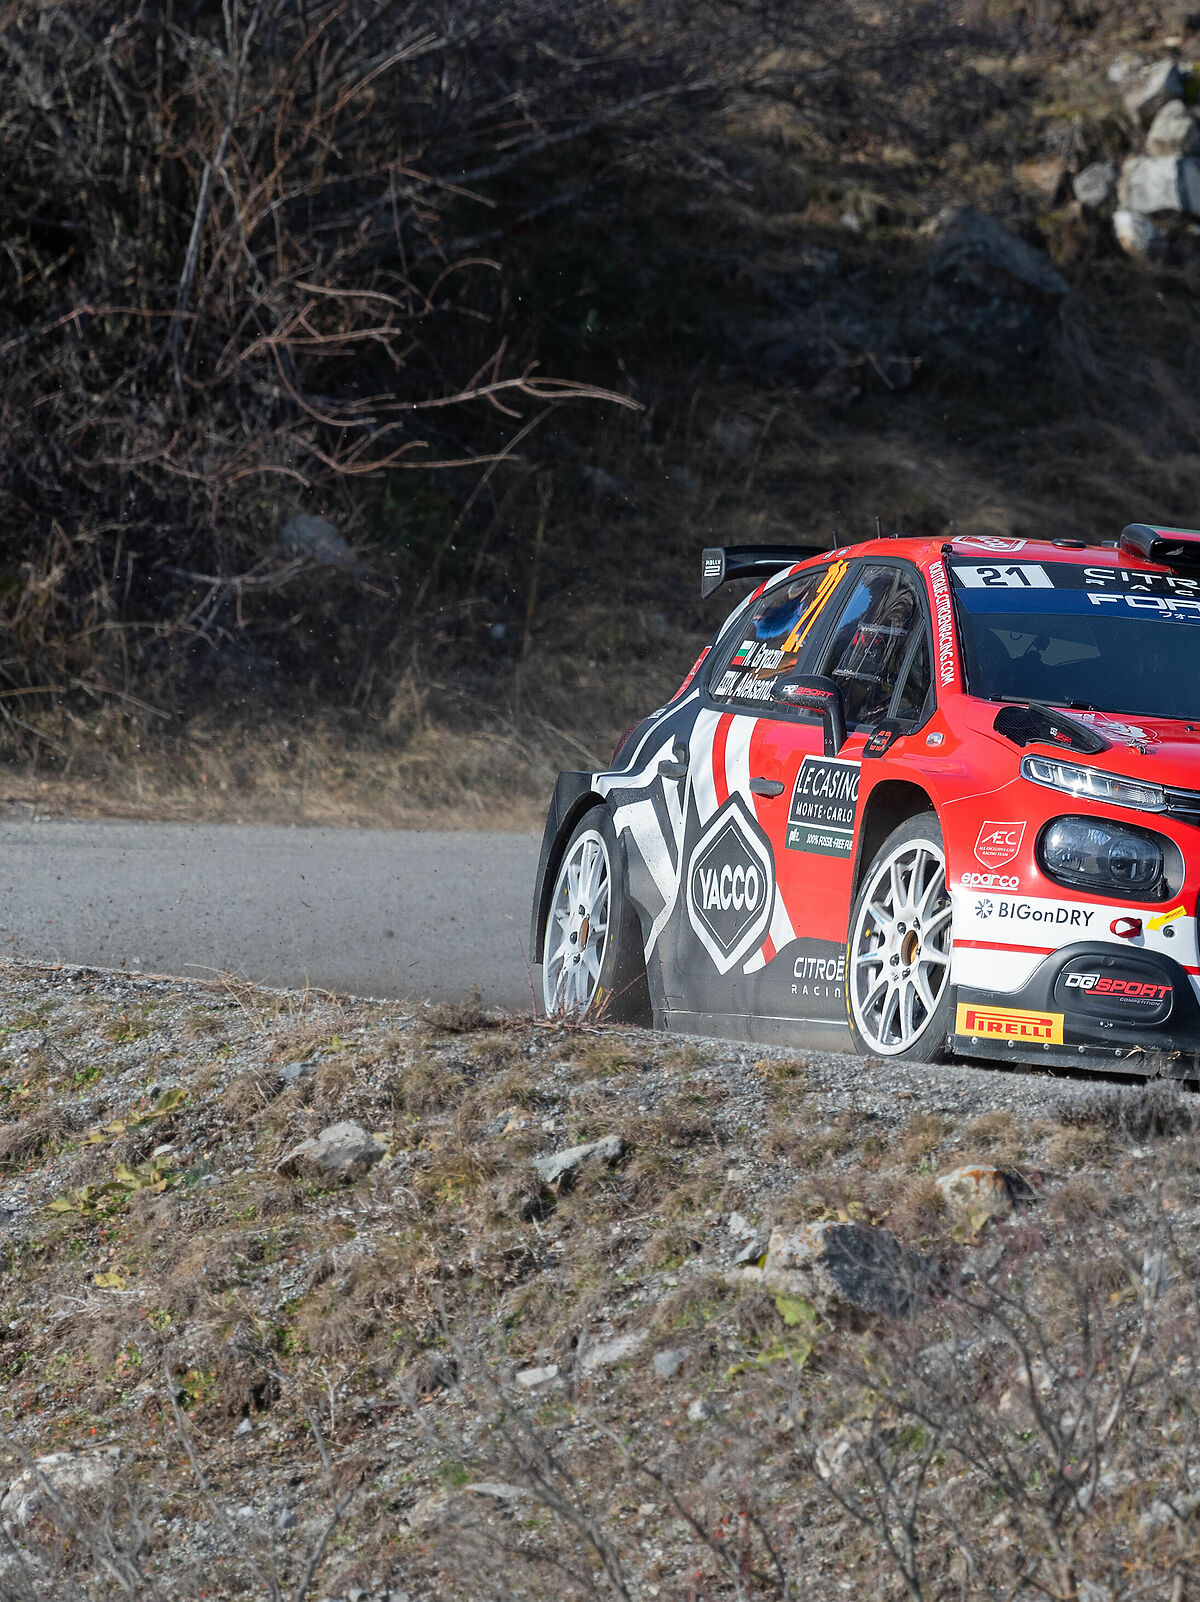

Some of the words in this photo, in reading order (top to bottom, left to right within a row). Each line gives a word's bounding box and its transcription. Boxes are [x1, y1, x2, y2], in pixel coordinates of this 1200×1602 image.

[976, 566, 1032, 587] 21
[796, 765, 815, 795] LE
[699, 864, 759, 911] YACCO
[960, 872, 1020, 889] sparco
[998, 902, 1095, 927] BIGonDRY
[793, 955, 845, 981] CITROË
[791, 984, 841, 998] RACIN
[1095, 978, 1173, 999] SPORT
[965, 1010, 1054, 1039] PIRELLI
